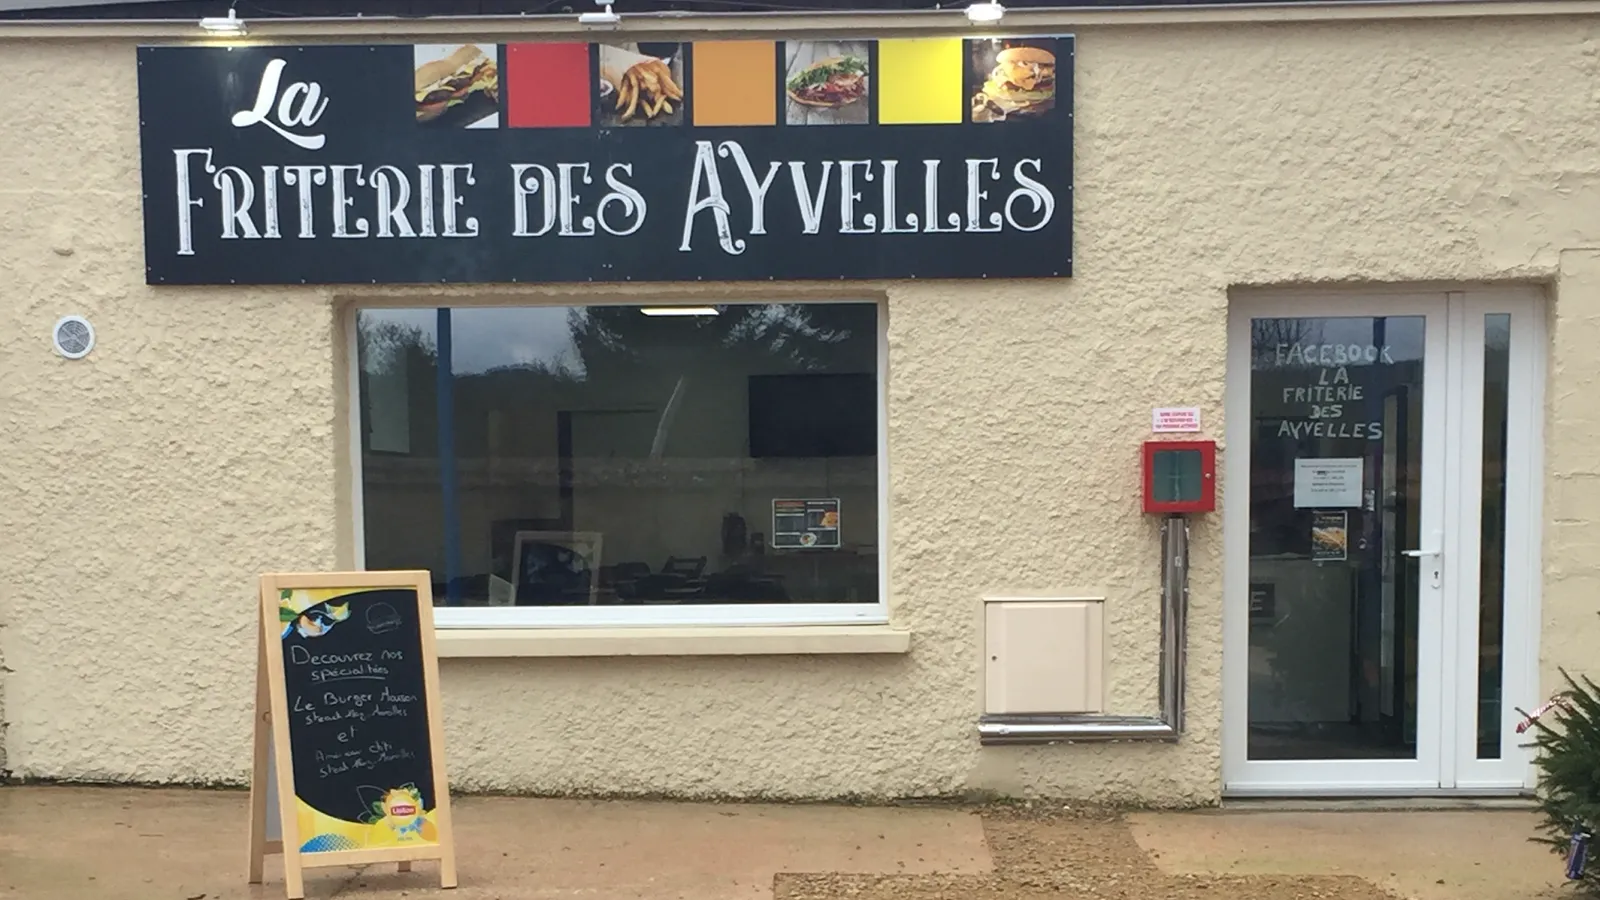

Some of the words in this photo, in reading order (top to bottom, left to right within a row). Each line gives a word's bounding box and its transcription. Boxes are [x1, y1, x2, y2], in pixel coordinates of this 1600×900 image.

[231, 57, 330, 150] La
[173, 147, 479, 256] FRITERIE
[511, 161, 647, 239] DES
[679, 140, 1055, 256] AYVELLES
[1275, 343, 1395, 366] FACEBOOK
[1318, 366, 1349, 386] LA
[1283, 384, 1363, 403] FRITERIE
[1309, 404, 1343, 419] DES
[1278, 420, 1383, 440] AYVELLES
[291, 645, 373, 665] Decouvrez
[381, 650, 403, 660] nos
[294, 696, 315, 712] Le
[324, 692, 372, 706] Burger
[337, 725, 357, 742] et
